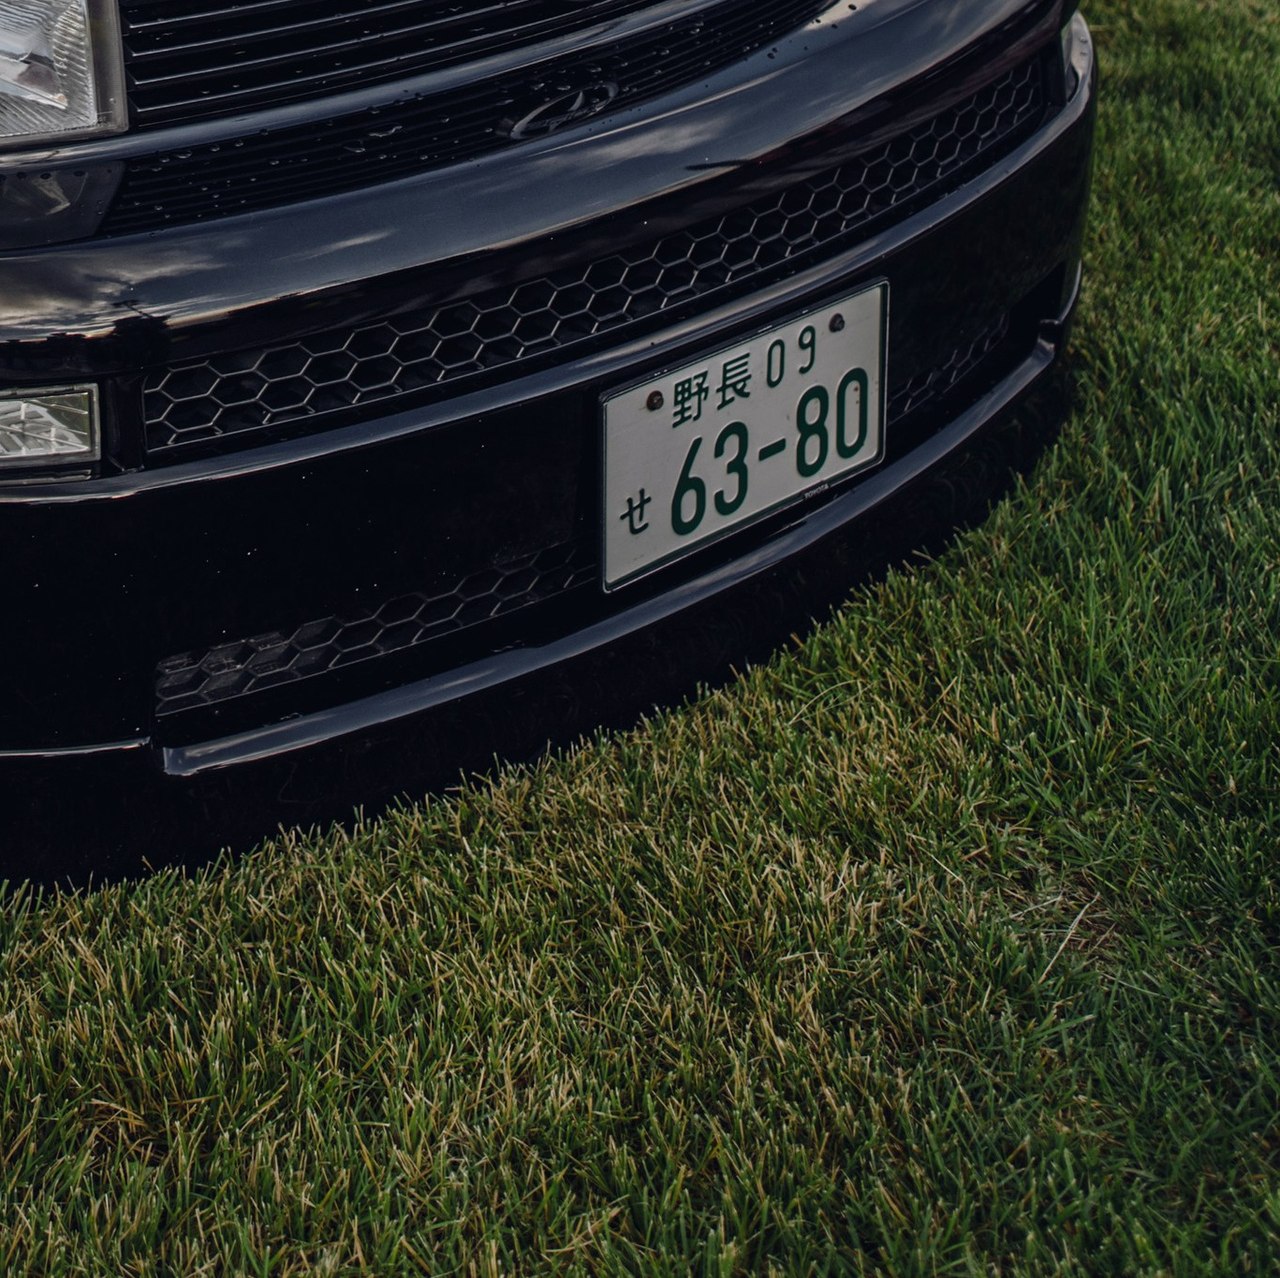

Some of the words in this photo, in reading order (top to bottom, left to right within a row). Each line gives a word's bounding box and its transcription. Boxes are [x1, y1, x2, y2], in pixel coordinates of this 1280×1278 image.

[672, 352, 752, 428] 野長
[766, 325, 816, 388] 09
[620, 488, 651, 535] せ
[671, 367, 868, 535] 63-80
